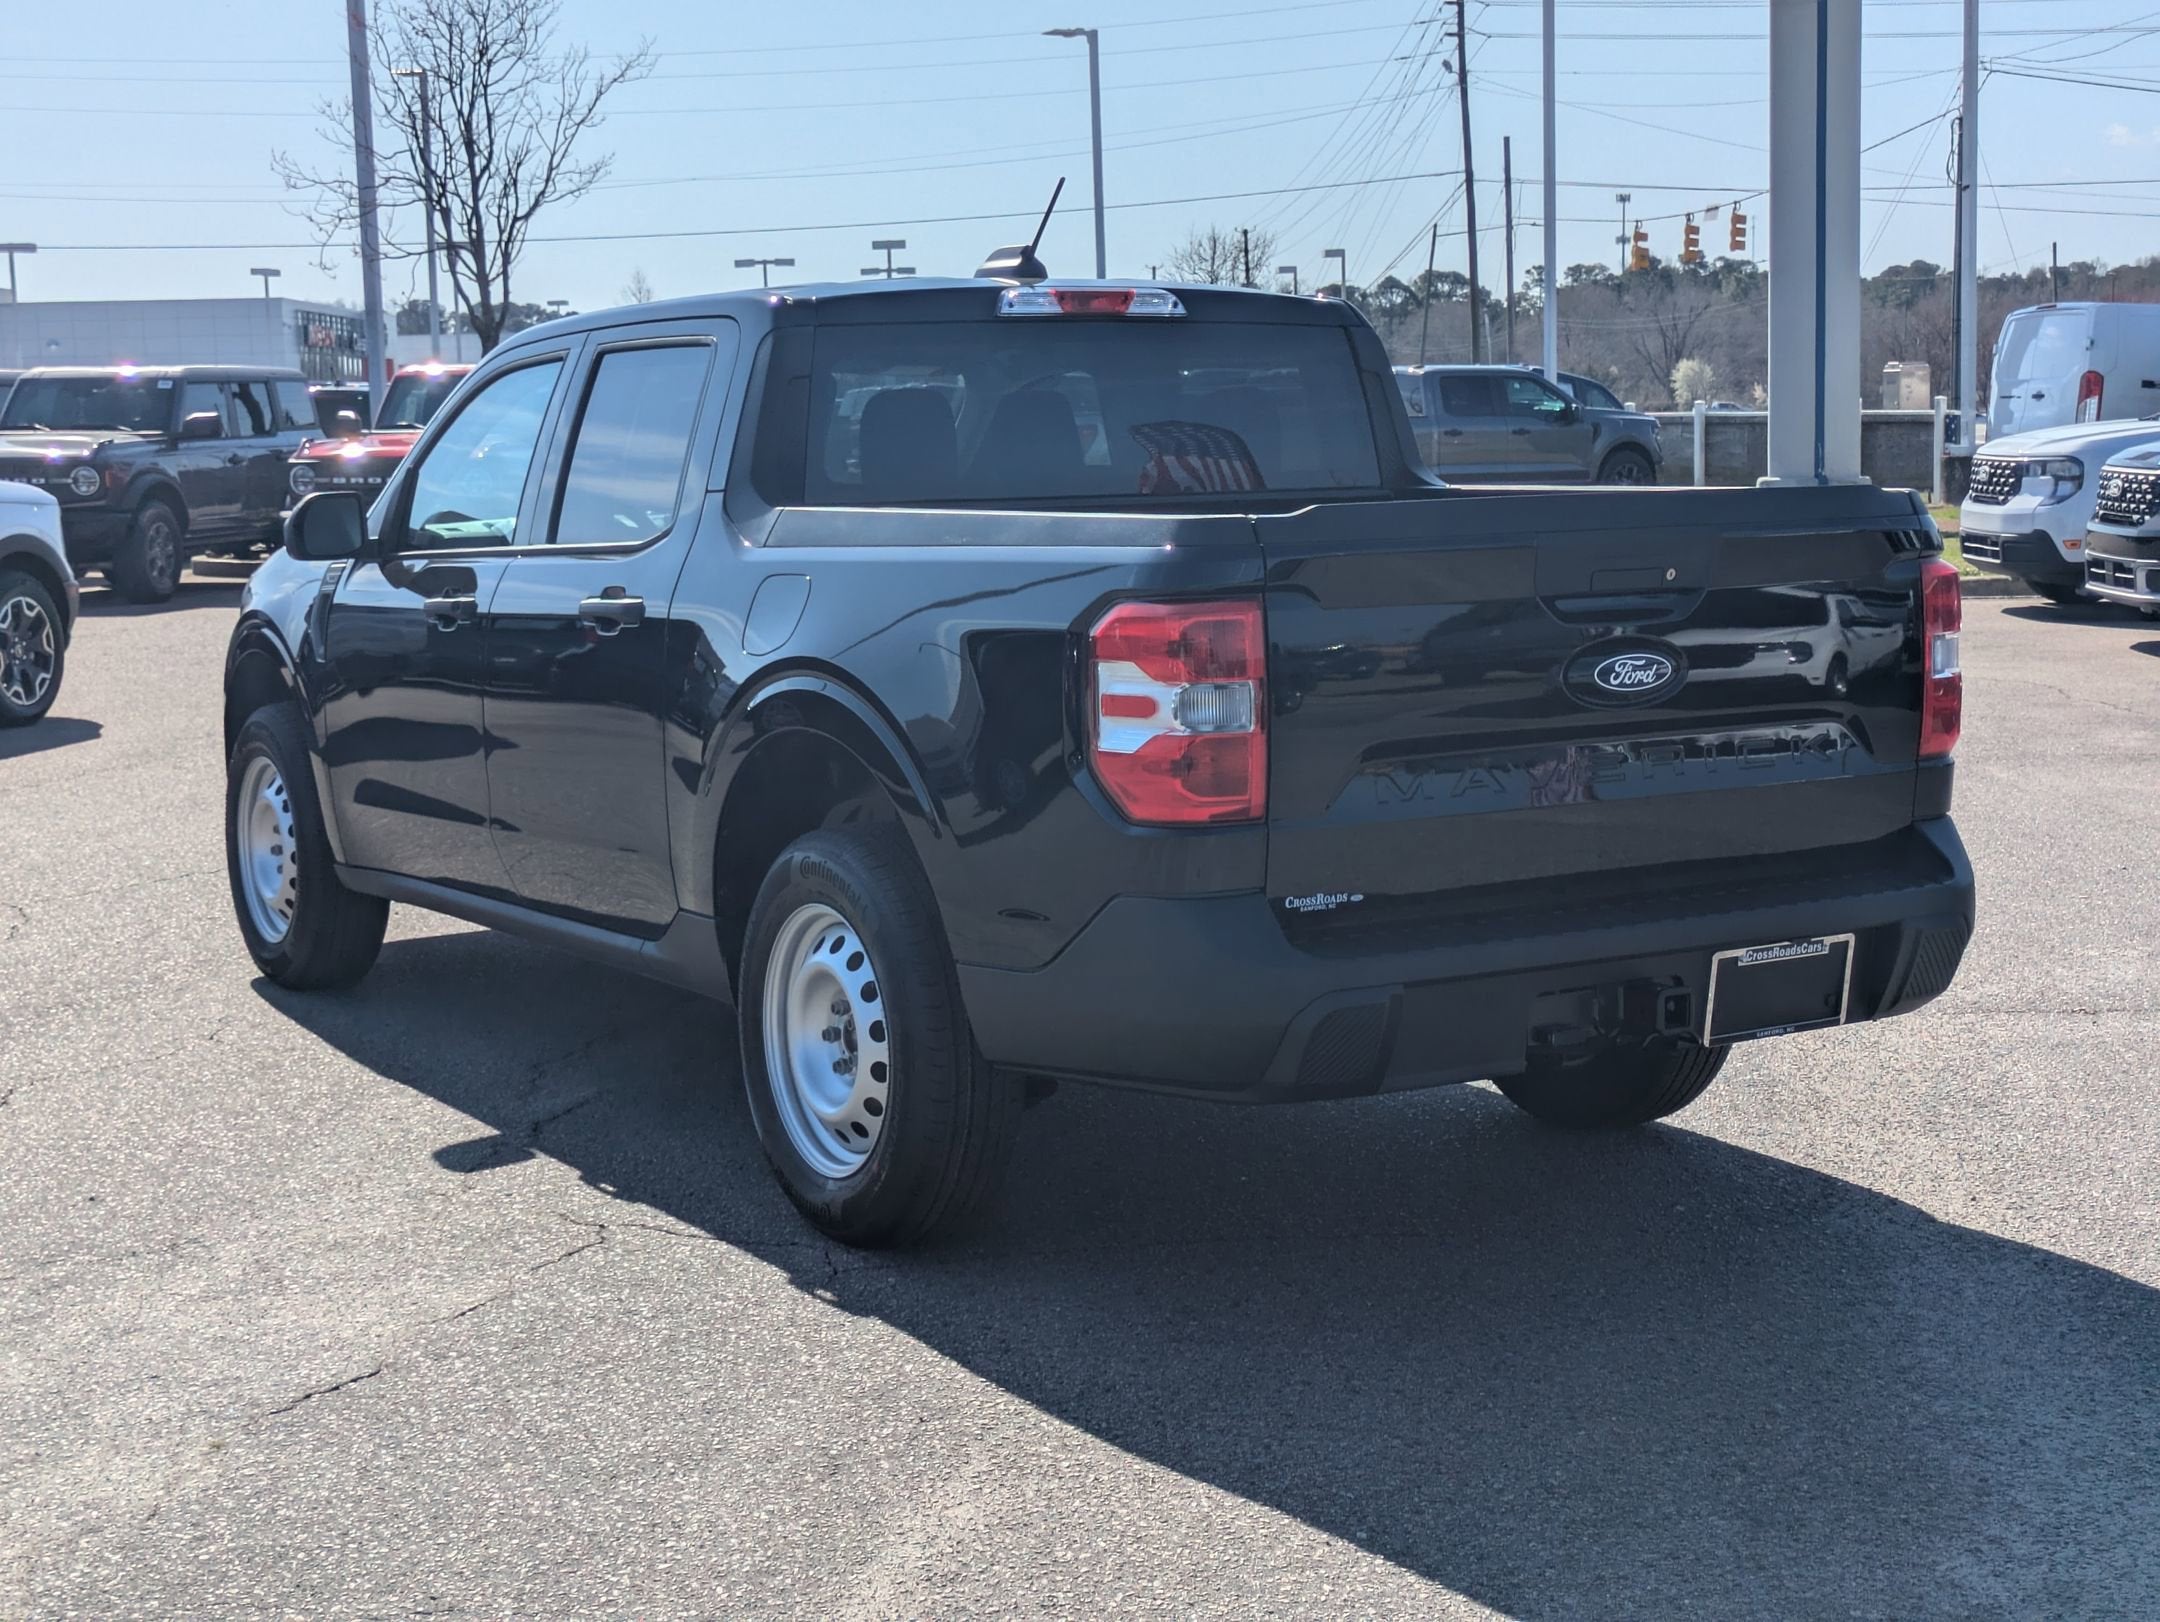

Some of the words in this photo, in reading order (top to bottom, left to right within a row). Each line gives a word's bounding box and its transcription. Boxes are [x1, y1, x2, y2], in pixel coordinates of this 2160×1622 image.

[1610, 659, 1657, 685] Ford
[1373, 731, 1834, 804] MAVERICK
[1746, 942, 1822, 962] CrossRoadsCars
